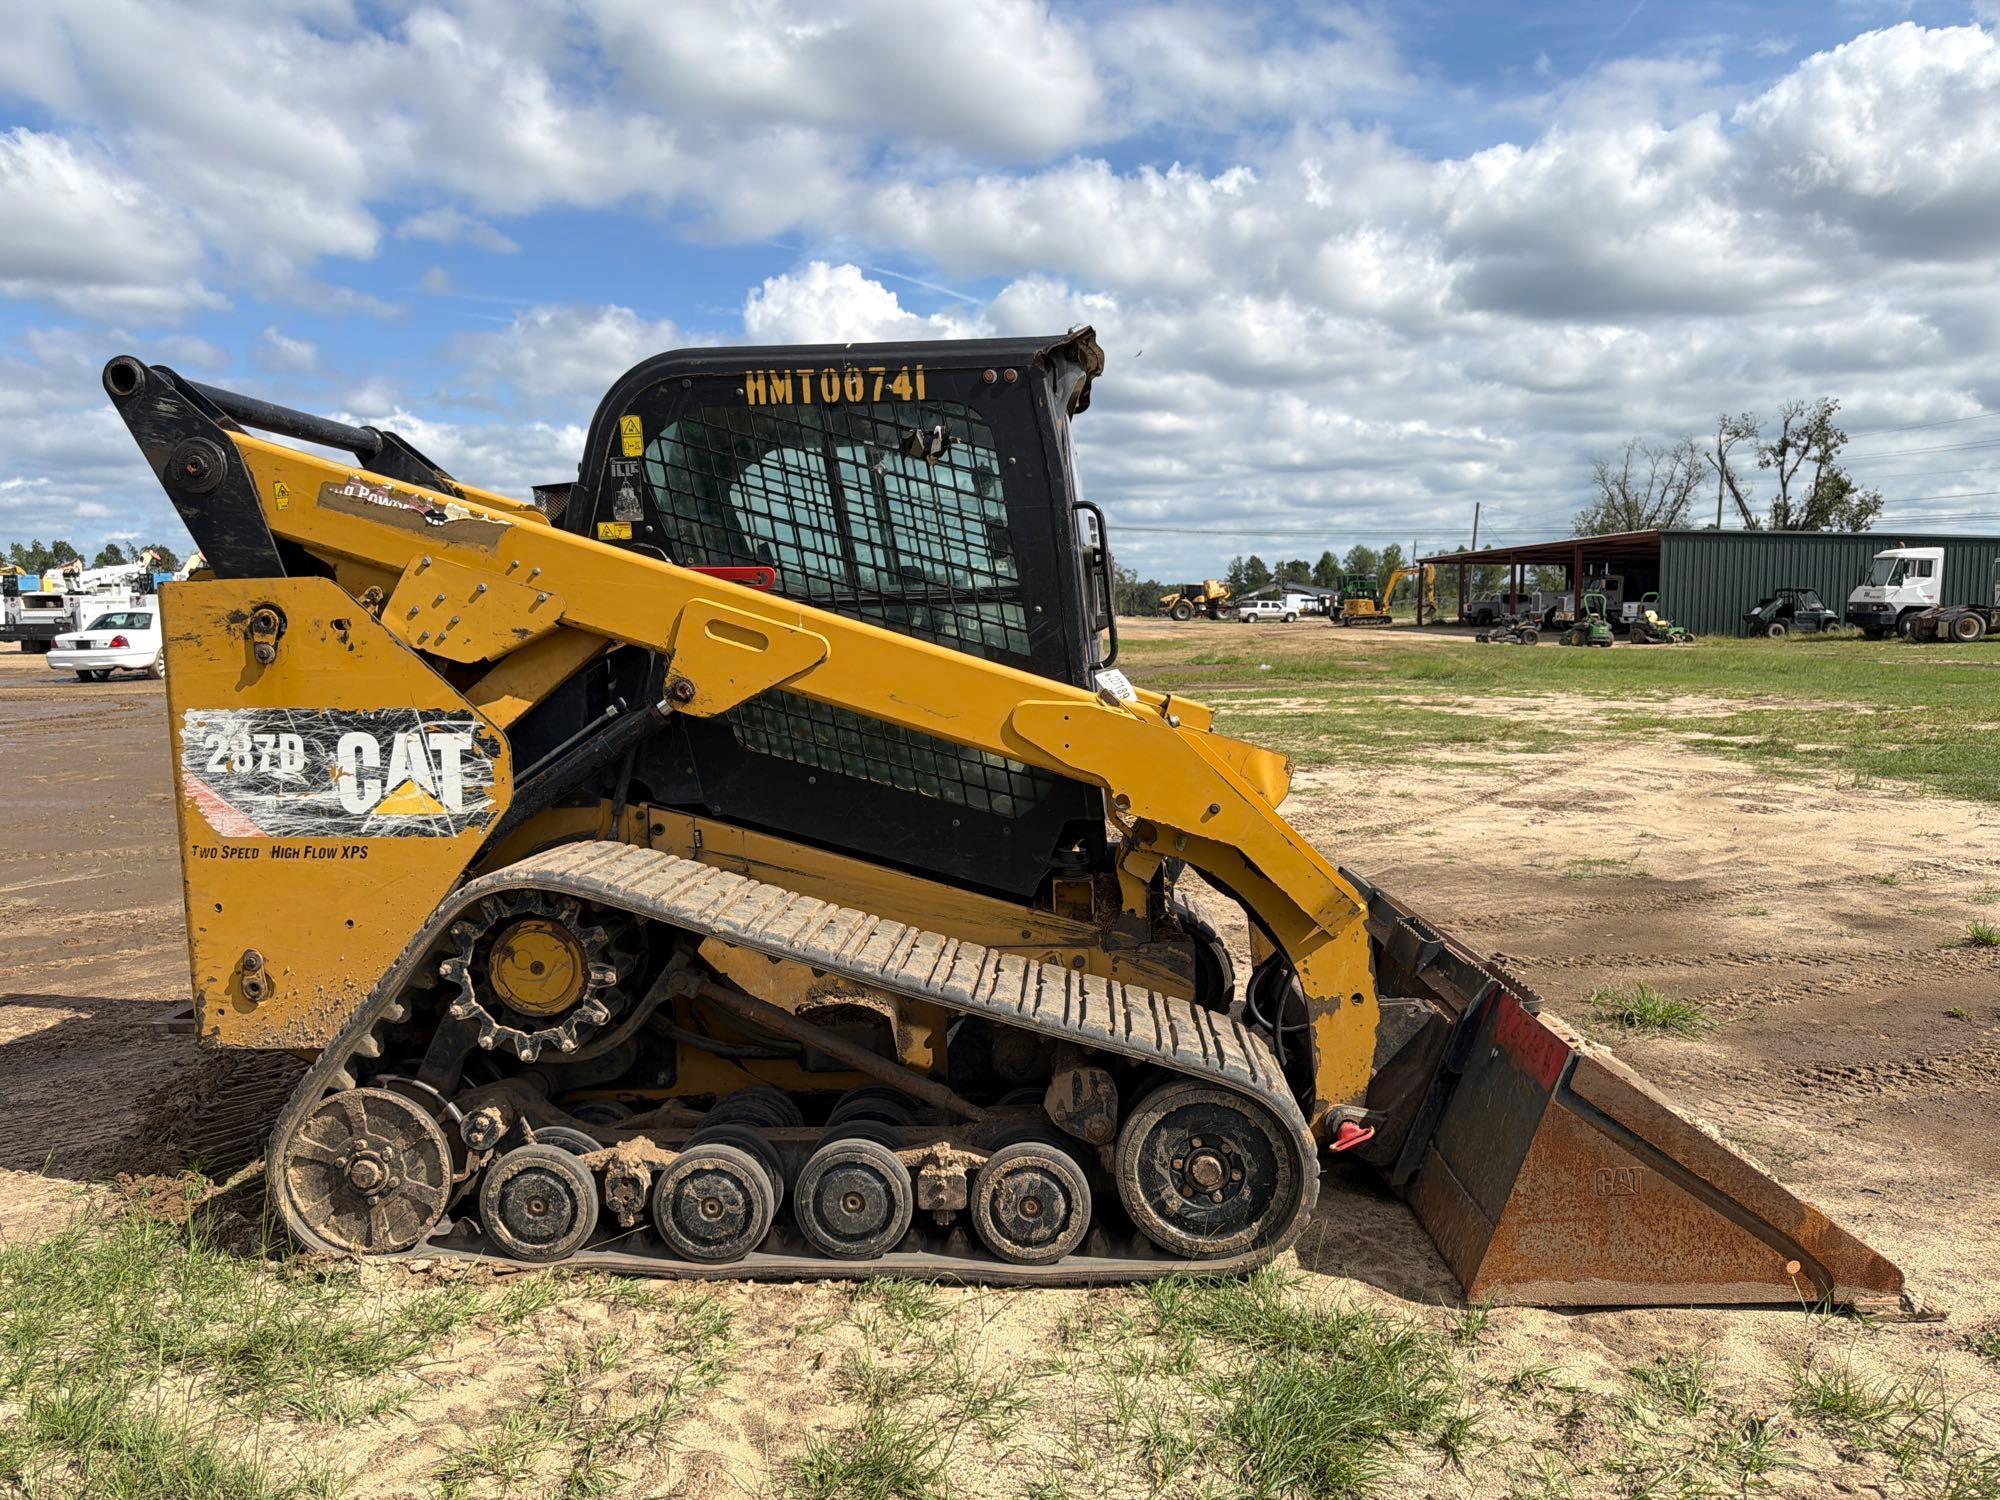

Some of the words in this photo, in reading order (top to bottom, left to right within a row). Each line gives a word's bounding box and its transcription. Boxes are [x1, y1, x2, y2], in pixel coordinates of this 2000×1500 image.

[204, 733, 305, 773] 287D
[337, 731, 473, 815] CAT
[341, 845, 369, 859] XPS
[1595, 1166, 1646, 1197] CAT
